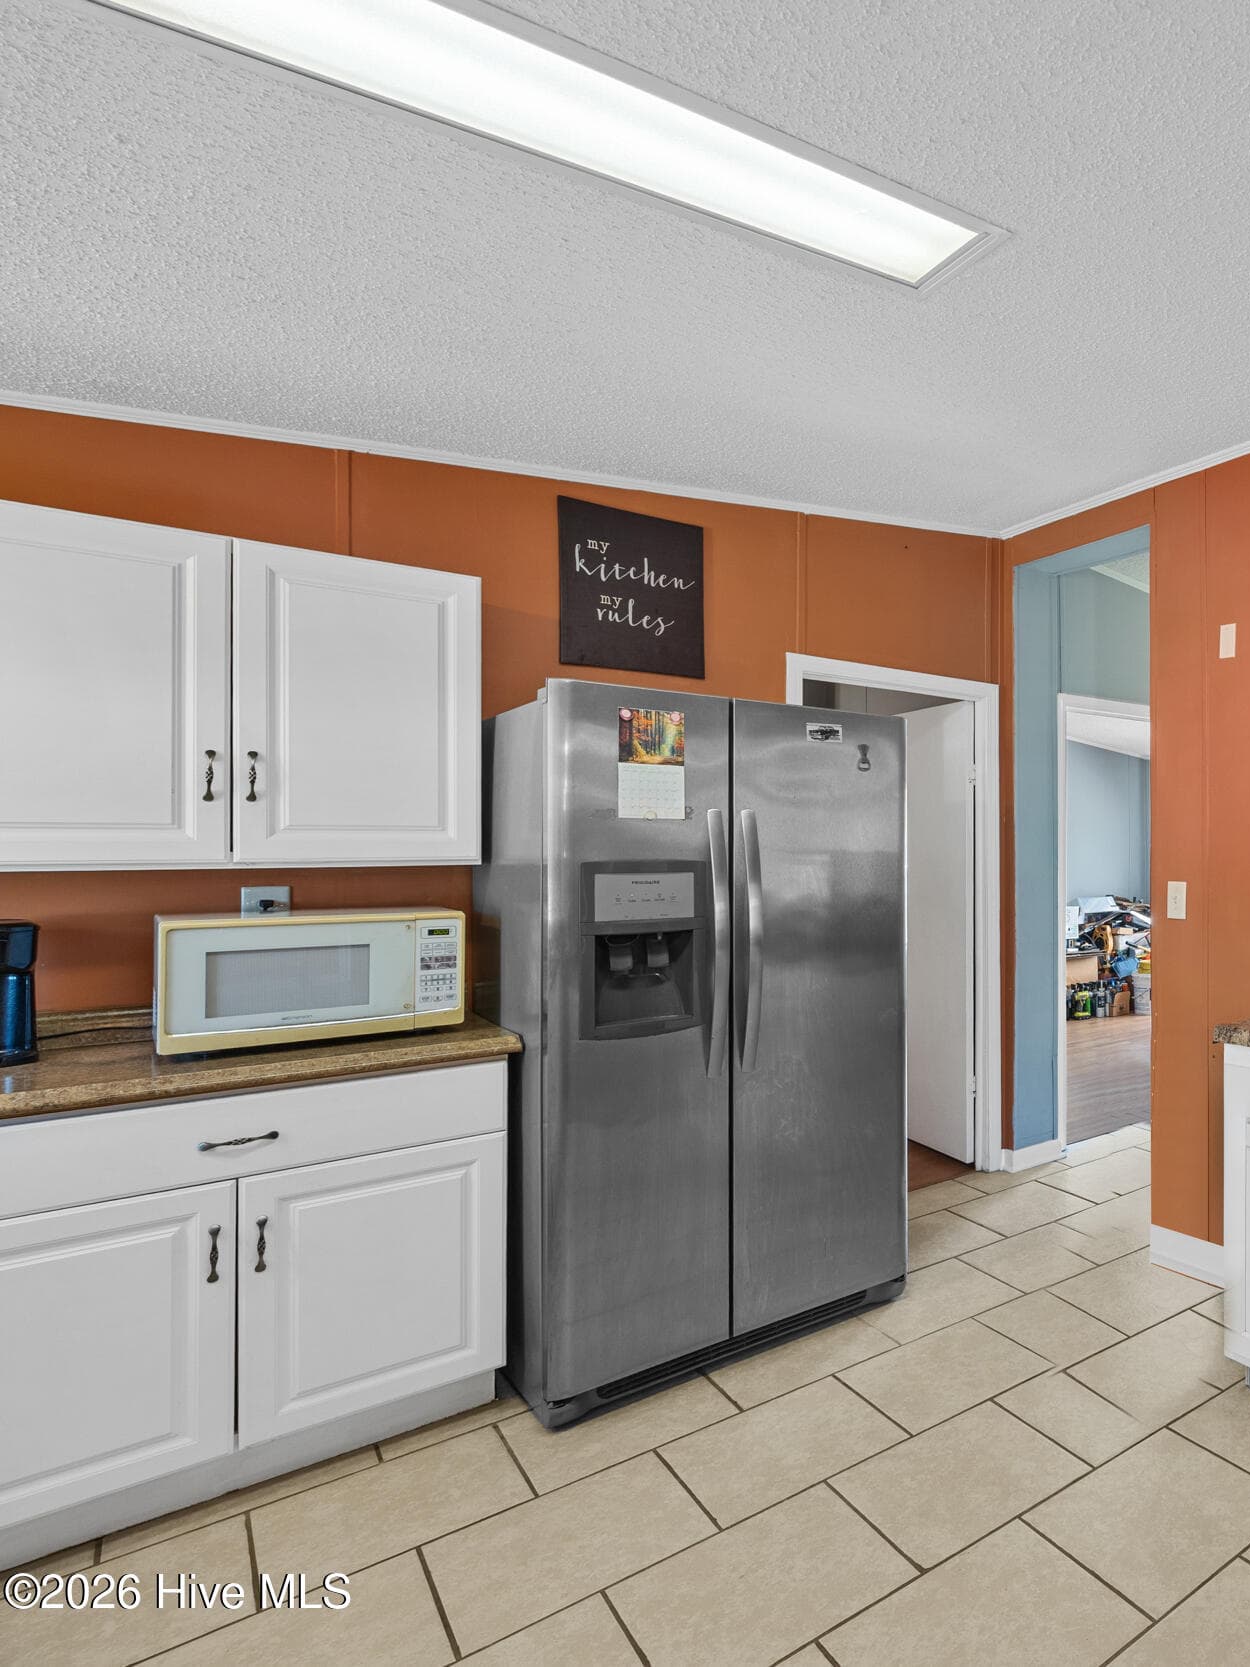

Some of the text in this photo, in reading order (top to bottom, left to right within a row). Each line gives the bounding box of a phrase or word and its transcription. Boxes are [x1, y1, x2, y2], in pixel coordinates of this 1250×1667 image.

[587, 538, 610, 554] my
[574, 543, 696, 590] kitchen
[600, 593, 622, 609] my
[596, 598, 675, 637] rules
